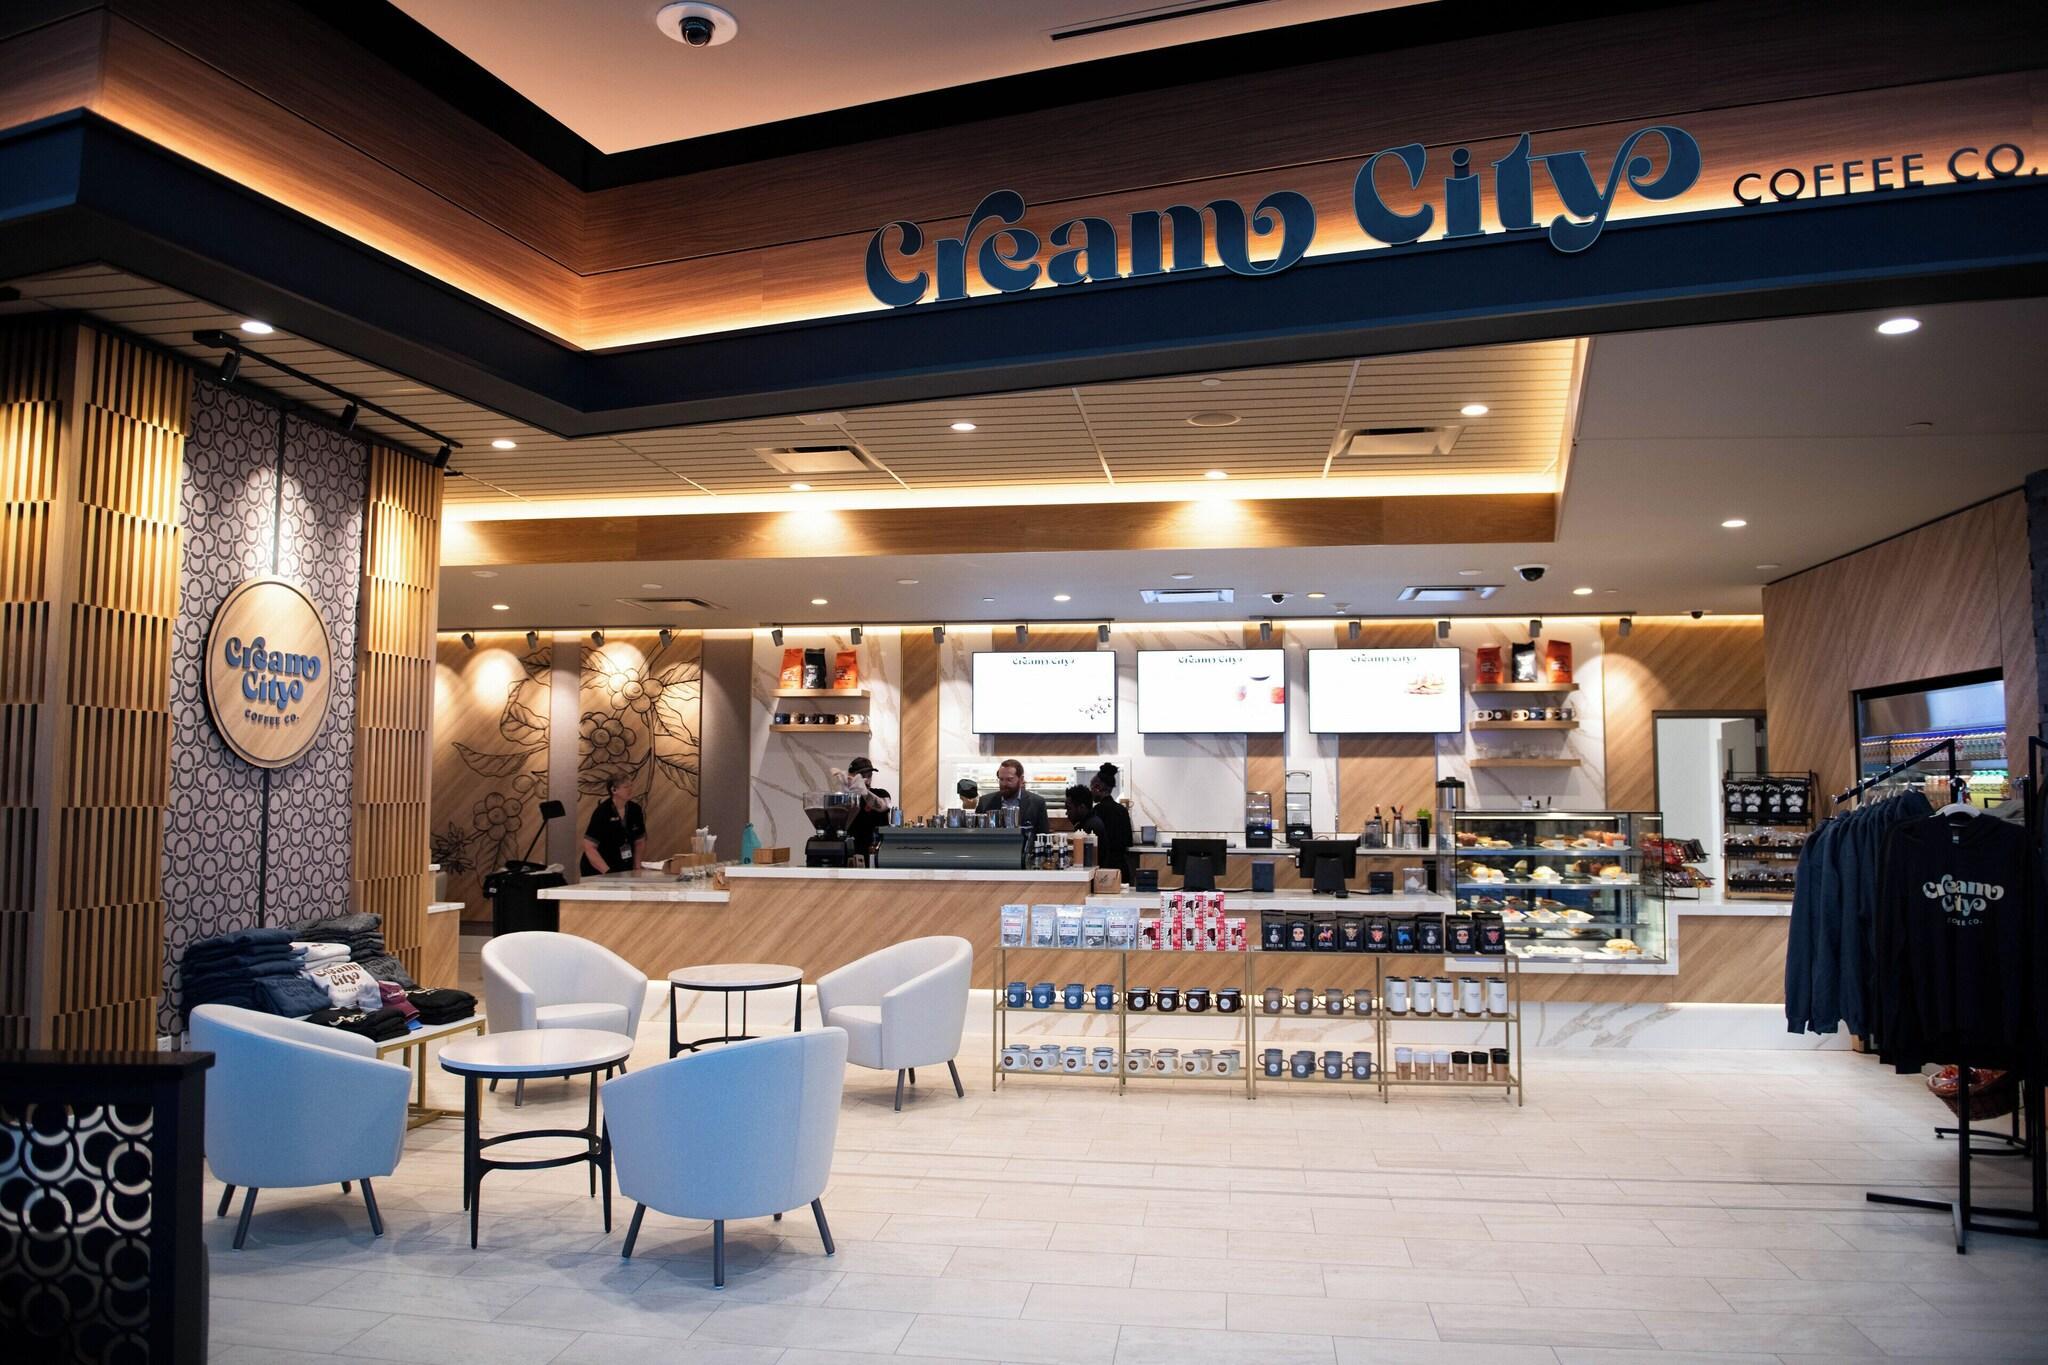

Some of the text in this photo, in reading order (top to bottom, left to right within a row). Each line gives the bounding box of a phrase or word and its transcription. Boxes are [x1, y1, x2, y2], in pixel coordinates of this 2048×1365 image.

[865, 125, 2040, 308] Cream City COFFEE CO.
[225, 636, 321, 681] Cream
[242, 670, 304, 711] City
[244, 708, 300, 726] COFFEE CO.
[1922, 873, 2005, 901] Cream
[330, 971, 360, 987] City
